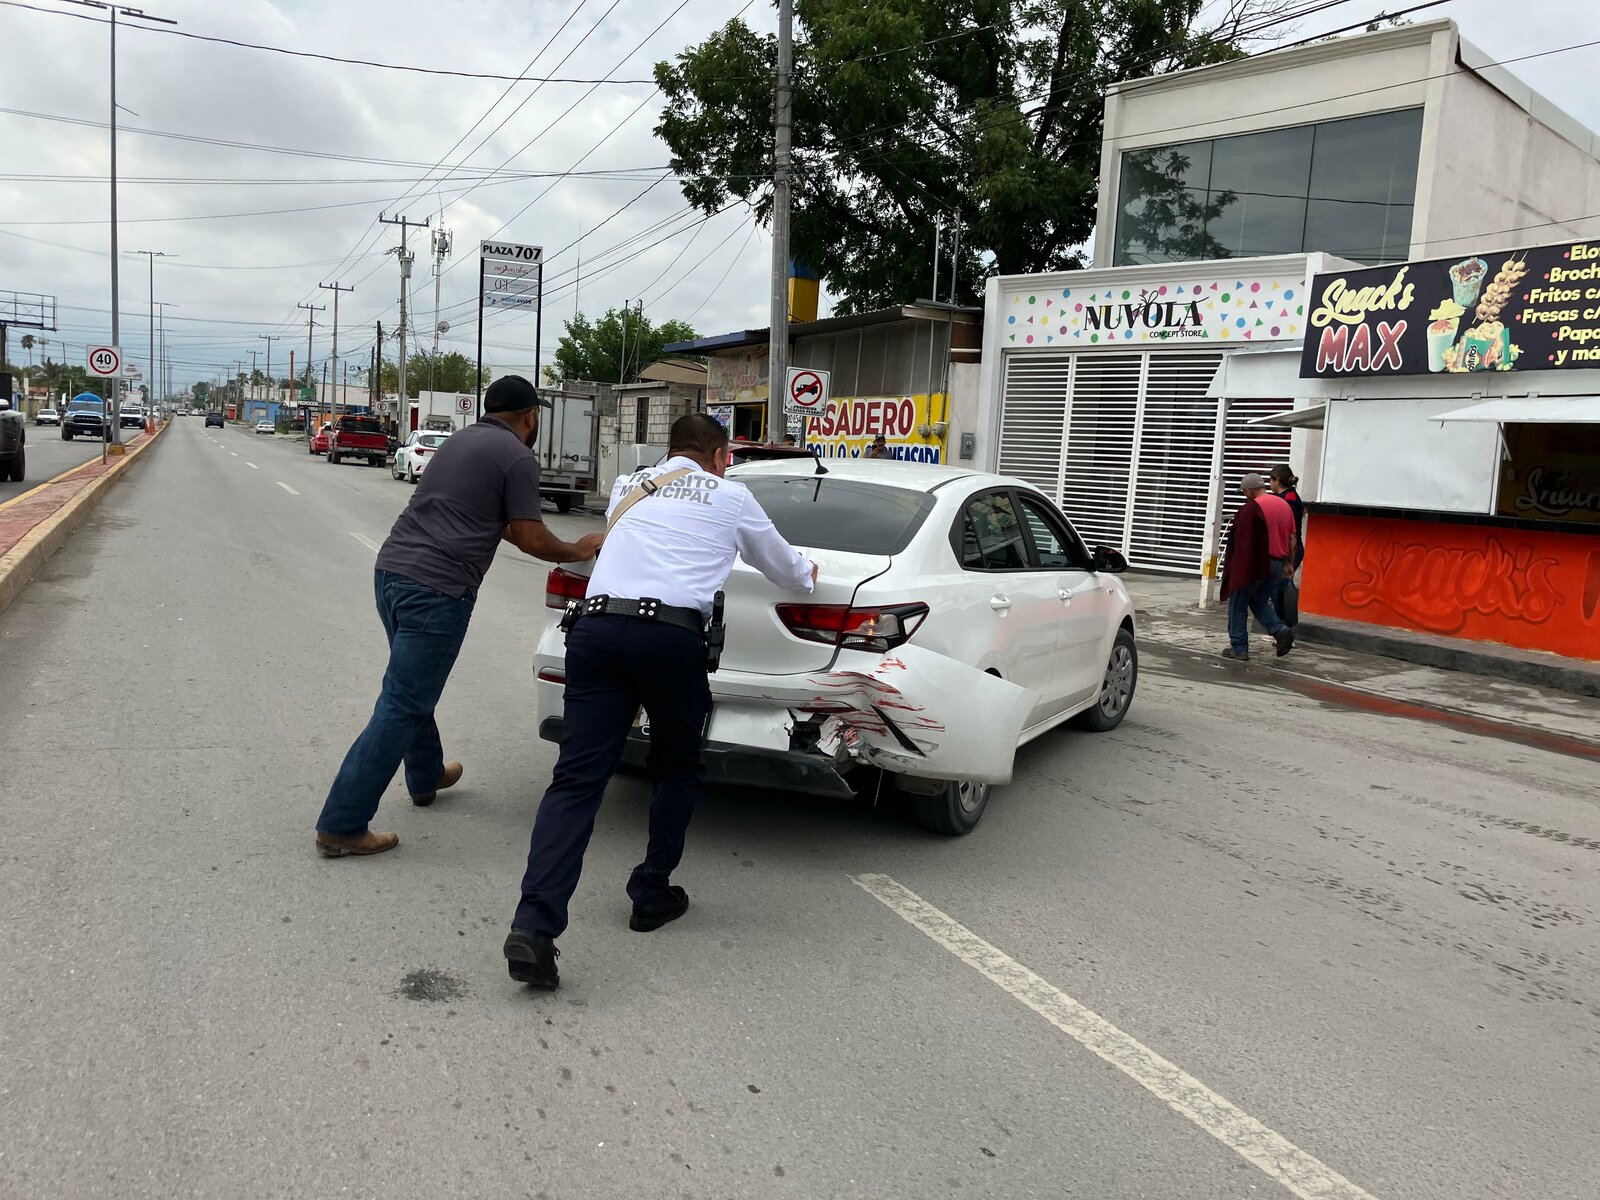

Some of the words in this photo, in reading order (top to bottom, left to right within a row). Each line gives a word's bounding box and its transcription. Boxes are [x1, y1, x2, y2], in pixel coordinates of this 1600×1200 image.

[483, 245, 514, 256] PLAZA
[515, 246, 542, 260] 707
[1570, 244, 1600, 261] Elo
[1550, 262, 1600, 283] Broch
[1529, 286, 1581, 304] Fritos
[1083, 300, 1203, 331] NUVOLA
[1522, 308, 1579, 324] Fresas
[1149, 330, 1179, 339] CONCEPT
[1180, 329, 1202, 338] STORE
[1316, 320, 1408, 373] MAX
[96, 353, 112, 365] 40
[1555, 349, 1569, 366] y
[463, 400, 469, 409] E
[807, 399, 914, 436] ASADERO
[629, 472, 719, 490] TRSITO
[620, 484, 713, 506] MICIPAL
[1340, 527, 1566, 635] Snack's
